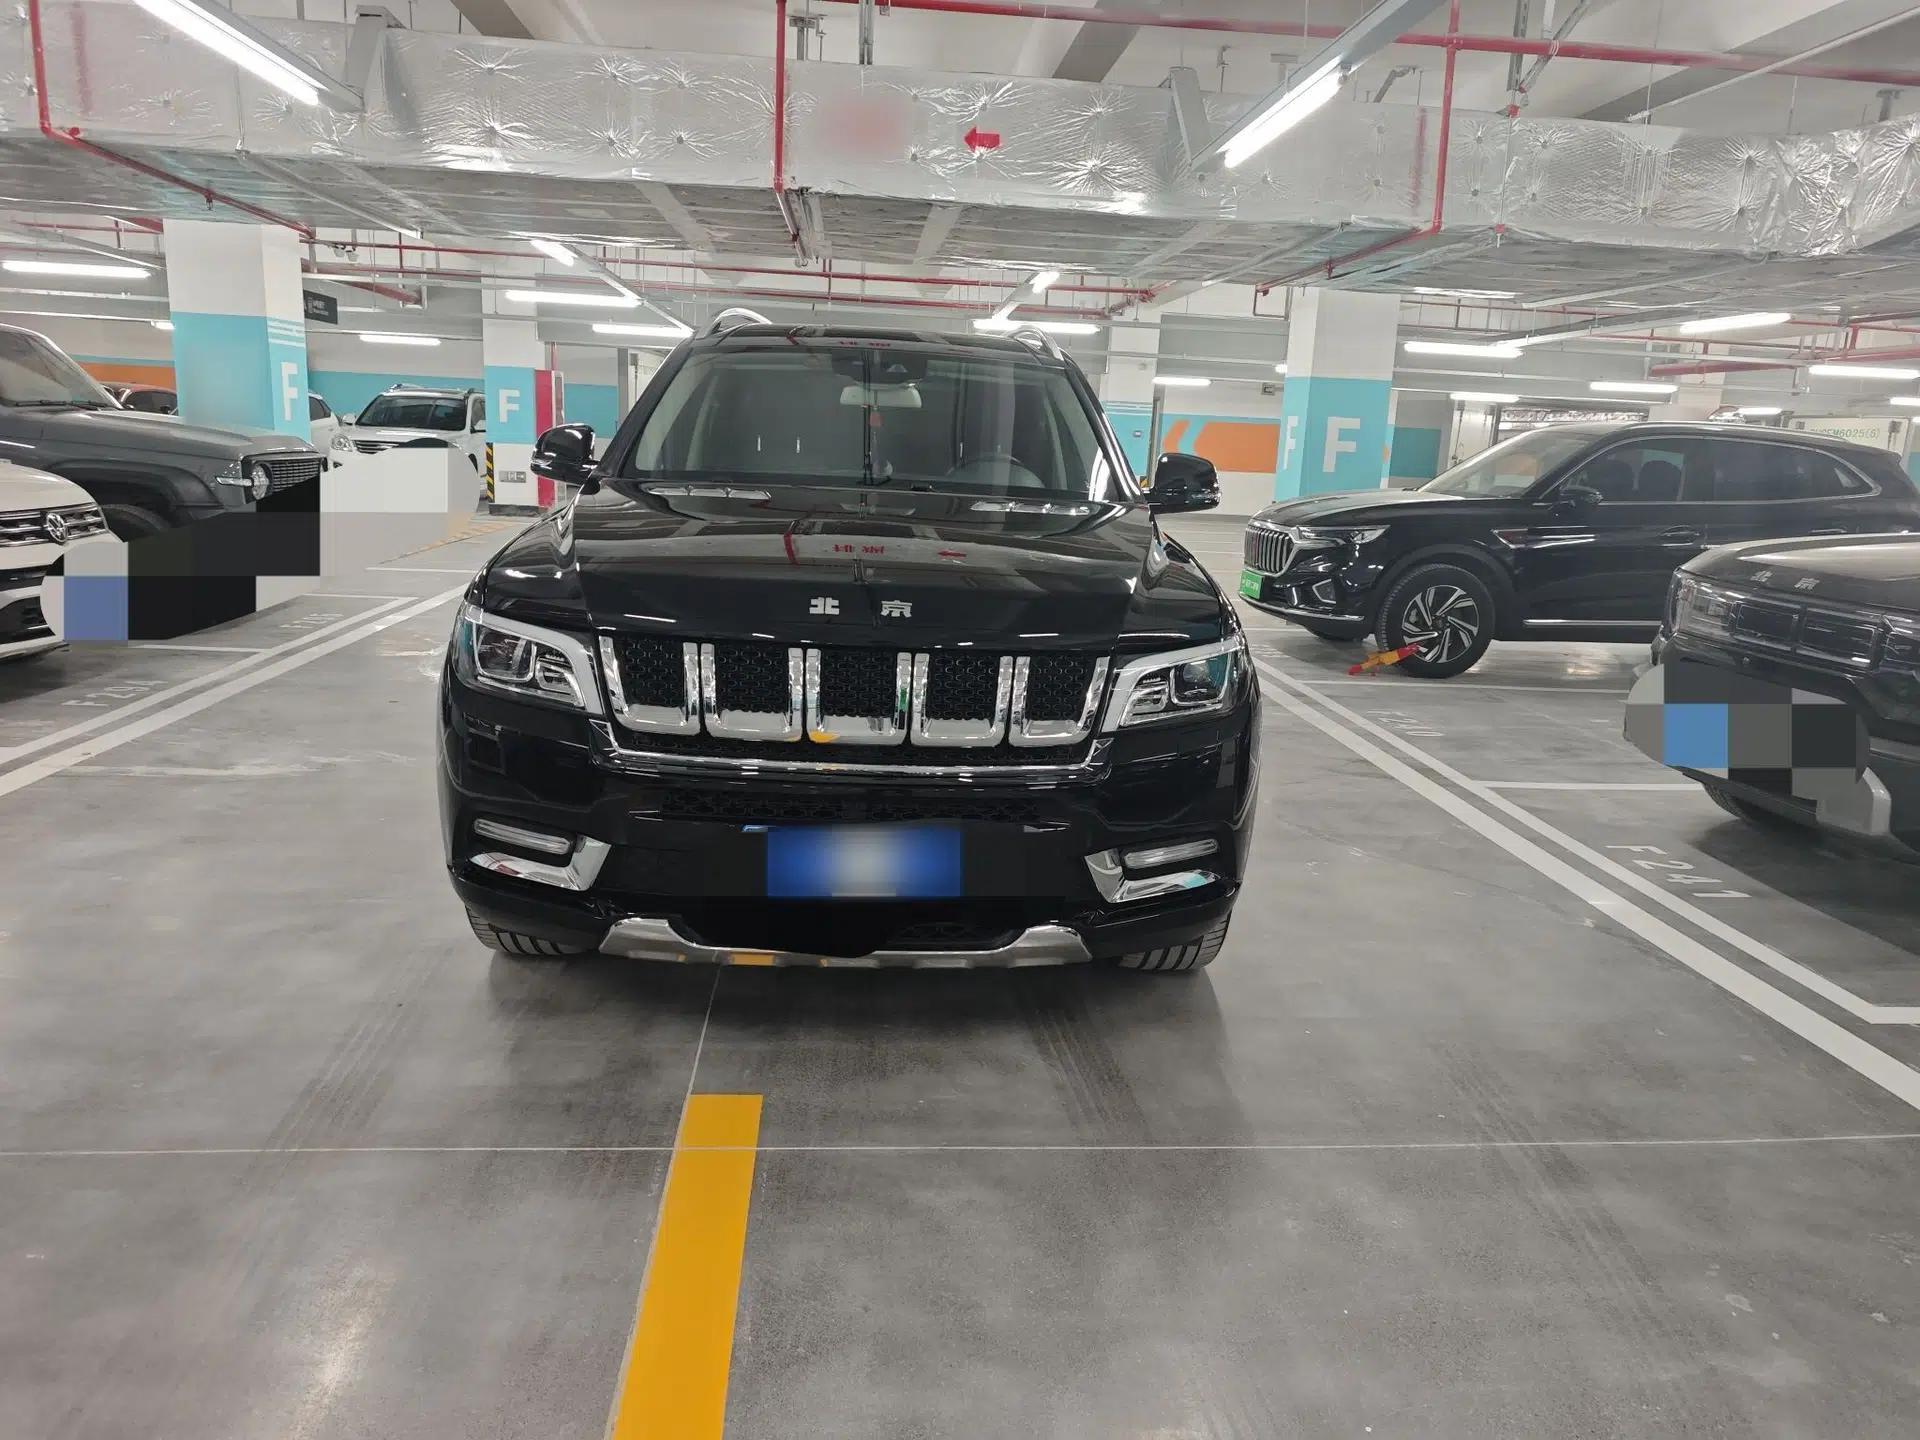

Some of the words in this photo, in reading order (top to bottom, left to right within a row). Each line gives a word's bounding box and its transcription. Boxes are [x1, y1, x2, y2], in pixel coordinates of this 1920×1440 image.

[281, 361, 299, 421] F
[499, 389, 520, 423] F
[1283, 415, 1299, 470] F
[1322, 416, 1361, 472] F
[809, 597, 912, 618] 北京
[1604, 845, 1753, 898] F241
